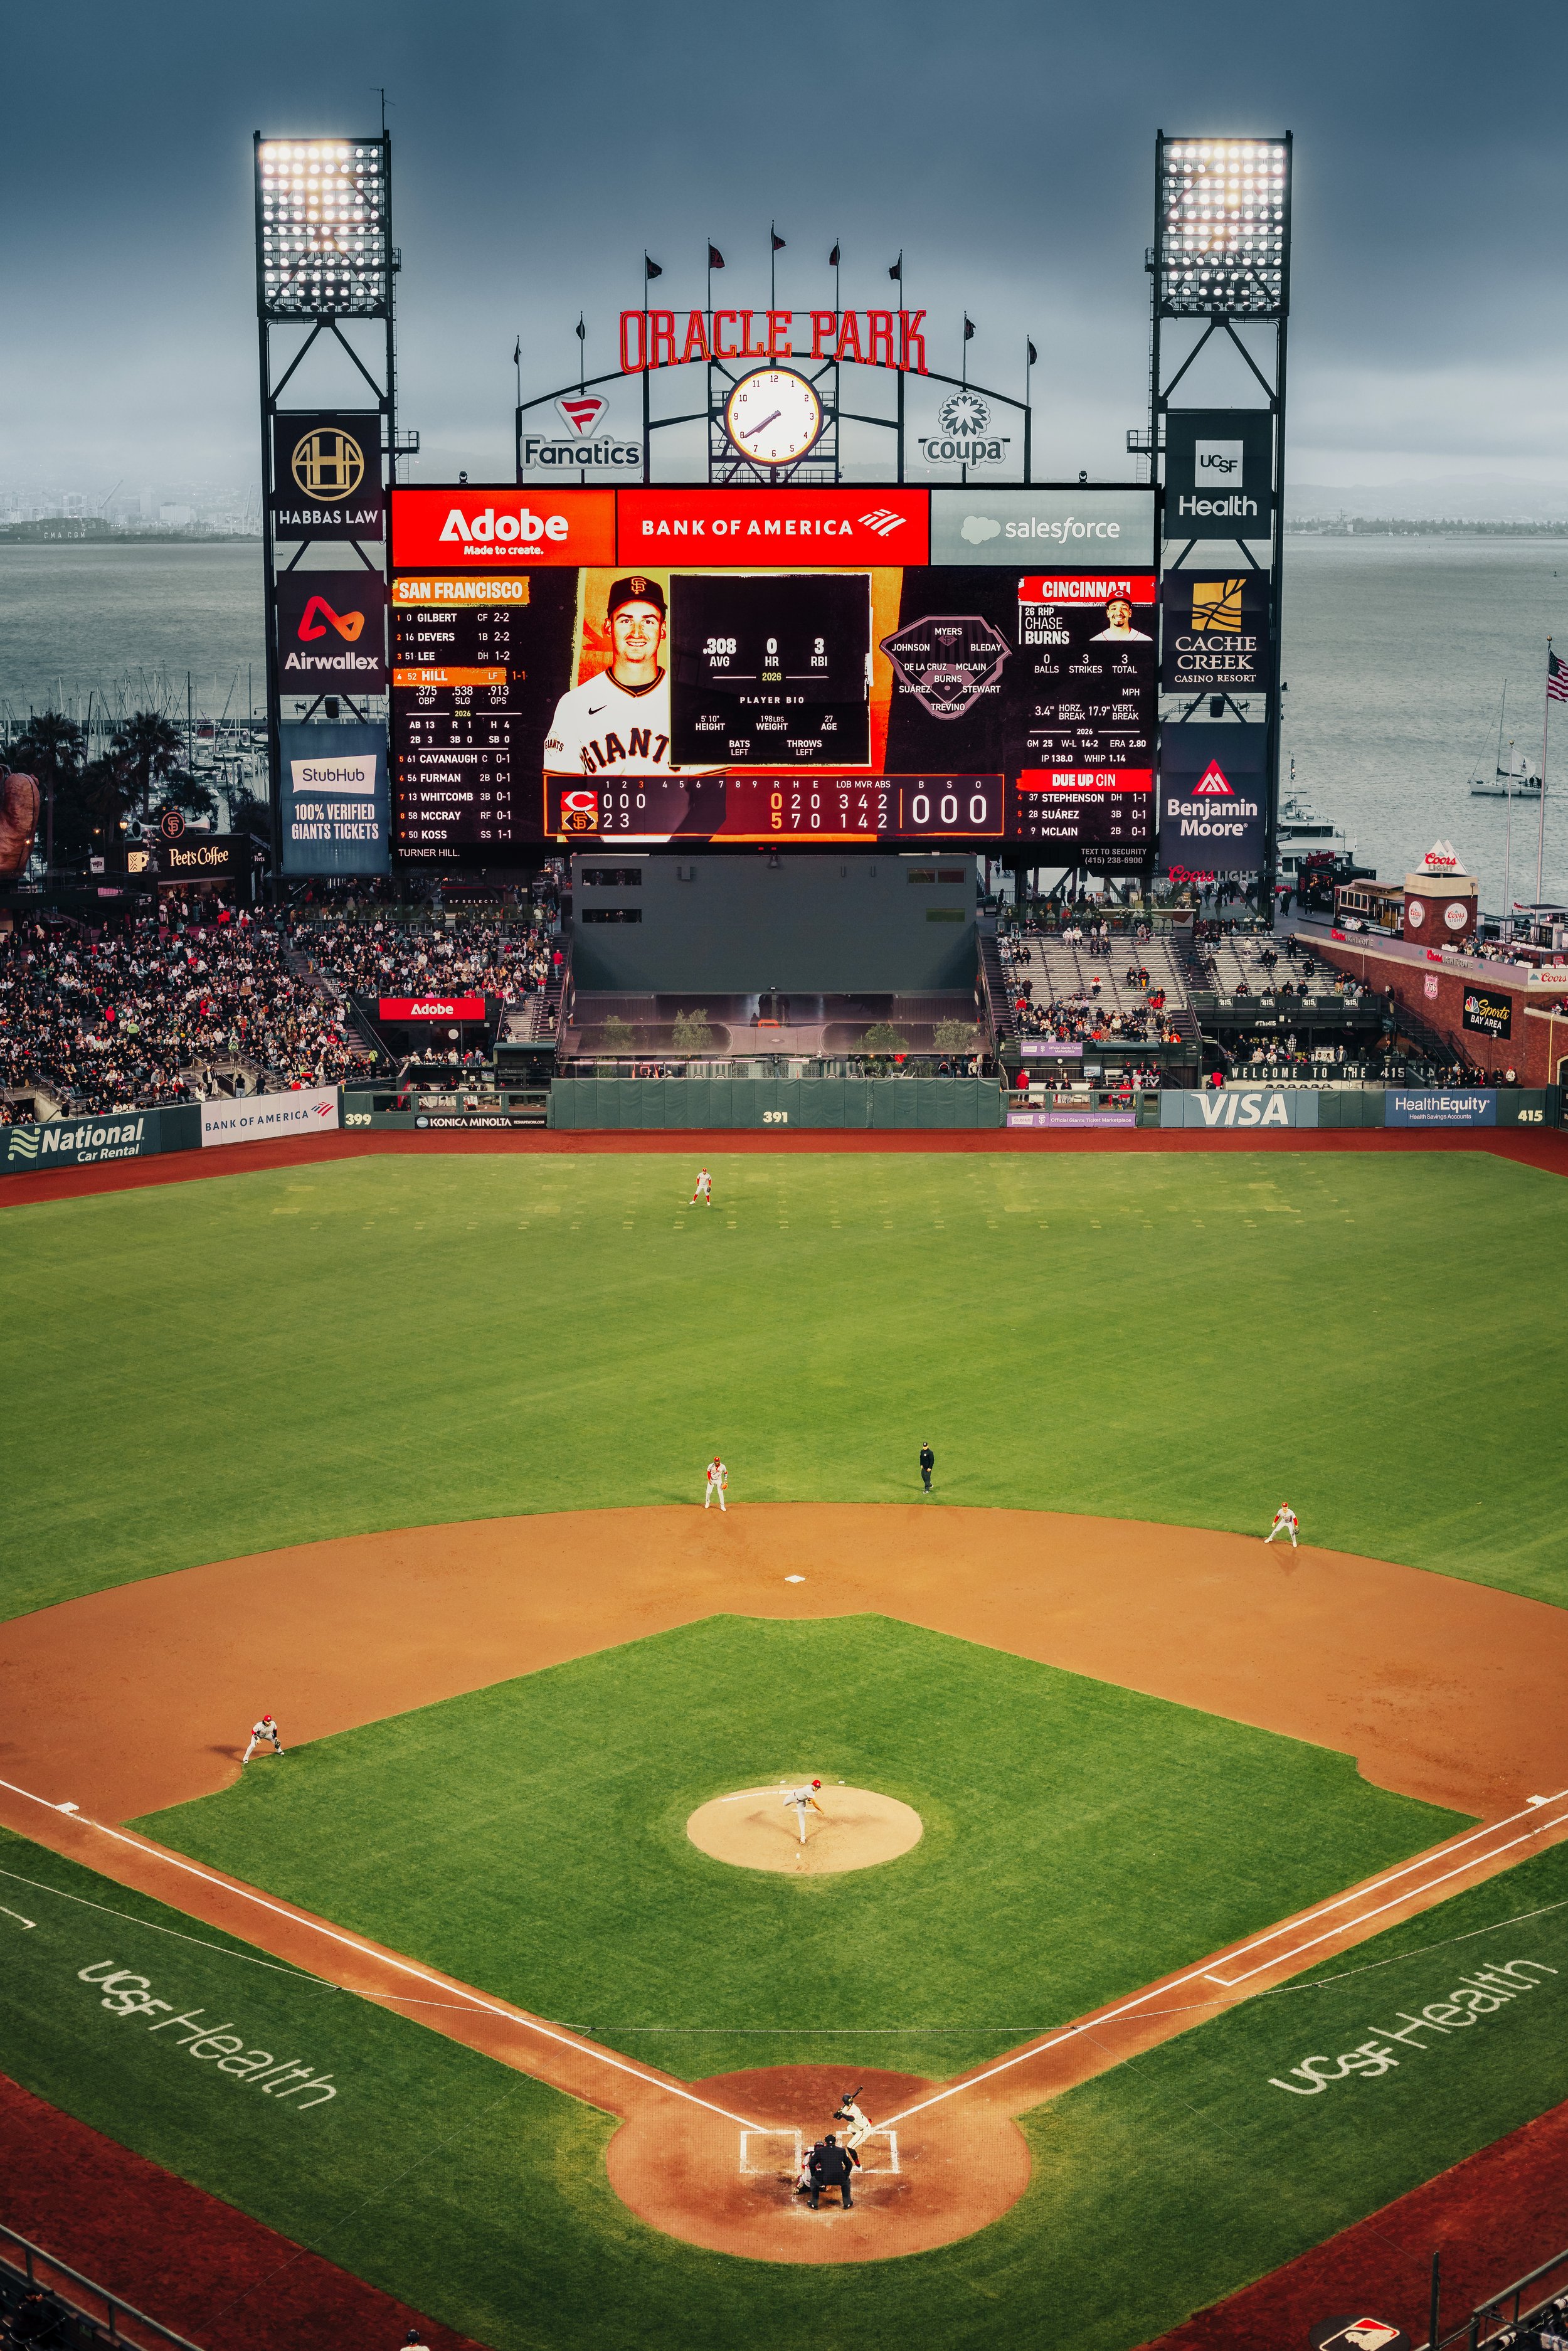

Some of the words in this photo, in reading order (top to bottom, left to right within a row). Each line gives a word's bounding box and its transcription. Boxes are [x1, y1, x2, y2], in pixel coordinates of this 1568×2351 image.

[620, 309, 793, 374] ORACLE
[810, 309, 929, 375] PARK
[524, 439, 641, 466] Fanatics
[927, 438, 1003, 466] coupa
[1200, 455, 1238, 473] UCSF
[1179, 496, 1257, 516] Health
[280, 510, 341, 524] HABBAS
[346, 510, 378, 524] LAW
[438, 508, 569, 541] Adobe
[642, 520, 705, 535] BANK
[712, 520, 741, 535] OF
[747, 520, 853, 535] AMERICA
[1005, 517, 1120, 544] salesforce
[464, 545, 494, 555] Made
[494, 546, 507, 555] to
[507, 545, 544, 555] create.
[399, 582, 431, 599] SAN
[435, 581, 522, 598] FRANCISCO
[1042, 581, 1130, 598] CINCINNATI
[417, 613, 457, 622] GILBERT
[1025, 607, 1035, 616] 26
[1038, 607, 1054, 615] RHP
[1025, 617, 1062, 629] CHASE
[418, 632, 455, 641] DEVERS
[935, 627, 962, 635] MYERS
[1025, 630, 1069, 644] BURNS
[703, 638, 736, 654] .308
[891, 644, 930, 652] JOHNSON
[970, 644, 1002, 652] BLEDAY
[1175, 636, 1257, 651] CACHE
[285, 652, 379, 670] Airwallex
[418, 652, 435, 661] LEE
[709, 656, 729, 667] AVG
[765, 656, 779, 666] HR
[811, 656, 827, 666] RBI
[1177, 655, 1254, 669] CREEK
[422, 671, 448, 681] HILL
[935, 675, 962, 683] BURNS
[416, 686, 437, 696] .375
[452, 686, 473, 696] .538
[488, 686, 509, 696] .913
[899, 683, 931, 693] SUÁREZ
[931, 703, 965, 711] TREVINO
[696, 723, 725, 731] HEIGHT
[544, 739, 564, 752] GIANTS
[787, 740, 822, 748] THROWS
[581, 727, 681, 774] GIANT
[420, 755, 477, 763] CAVANAUGH
[302, 768, 364, 782] StubHub
[420, 773, 461, 782] FURMAN
[1052, 773, 1076, 787] DUE
[1078, 773, 1094, 787] UP
[1096, 773, 1116, 787] CIN
[420, 792, 474, 801] WHITCOMB
[1042, 793, 1104, 802] STEPHENSON
[295, 804, 324, 820] 100%
[327, 804, 374, 820] VERIFIED
[421, 811, 461, 820] MCCRAY
[1042, 809, 1079, 819] SUÁREZ
[1168, 799, 1258, 820] Benjamin
[292, 824, 331, 839] GIANTS
[334, 823, 379, 839] TICKETS
[421, 831, 447, 839] KOSS
[1042, 827, 1078, 836] MCLAIN
[198, 846, 229, 866] Coffee
[398, 849, 436, 857] TURNER
[1424, 852, 1457, 865] Coors
[1085, 857, 1104, 865] (415)
[1168, 864, 1216, 883] Coors
[1217, 870, 1258, 881] LIGHT
[1428, 864, 1454, 873] LIGHT
[1410, 908, 1421, 918] Coors
[1541, 972, 1567, 982] Coors
[1427, 982, 1437, 992] 756
[411, 1003, 453, 1015] Adobe
[1478, 999, 1510, 1020] Sports
[1470, 1014, 1485, 1024] BAY
[1484, 1019, 1502, 1030] AREA
[1232, 1067, 1298, 1078] WELCOME
[1313, 1068, 1327, 1078] TO
[1343, 1067, 1366, 1078] THE
[1380, 1068, 1405, 1078] 415
[1190, 1093, 1289, 1125] VISA
[1396, 1097, 1486, 1113] HealthEquity
[205, 1118, 236, 1132] BANK
[240, 1117, 255, 1127] OF
[257, 1110, 309, 1125] AMERICA
[345, 1113, 371, 1126] 399
[763, 1112, 788, 1123] 391
[1518, 1110, 1543, 1122] 415
[430, 1118, 468, 1127] KONICA
[469, 1118, 512, 1127] MINOLTA
[41, 1118, 142, 1152] National
[77, 1150, 98, 1162] Car
[100, 1144, 139, 1160] Rental
[1268, 2041, 1400, 2094] UCSF
[1367, 1960, 1559, 2049] Health
[77, 1960, 173, 2017] UCSF
[148, 2008, 336, 2110] Health
